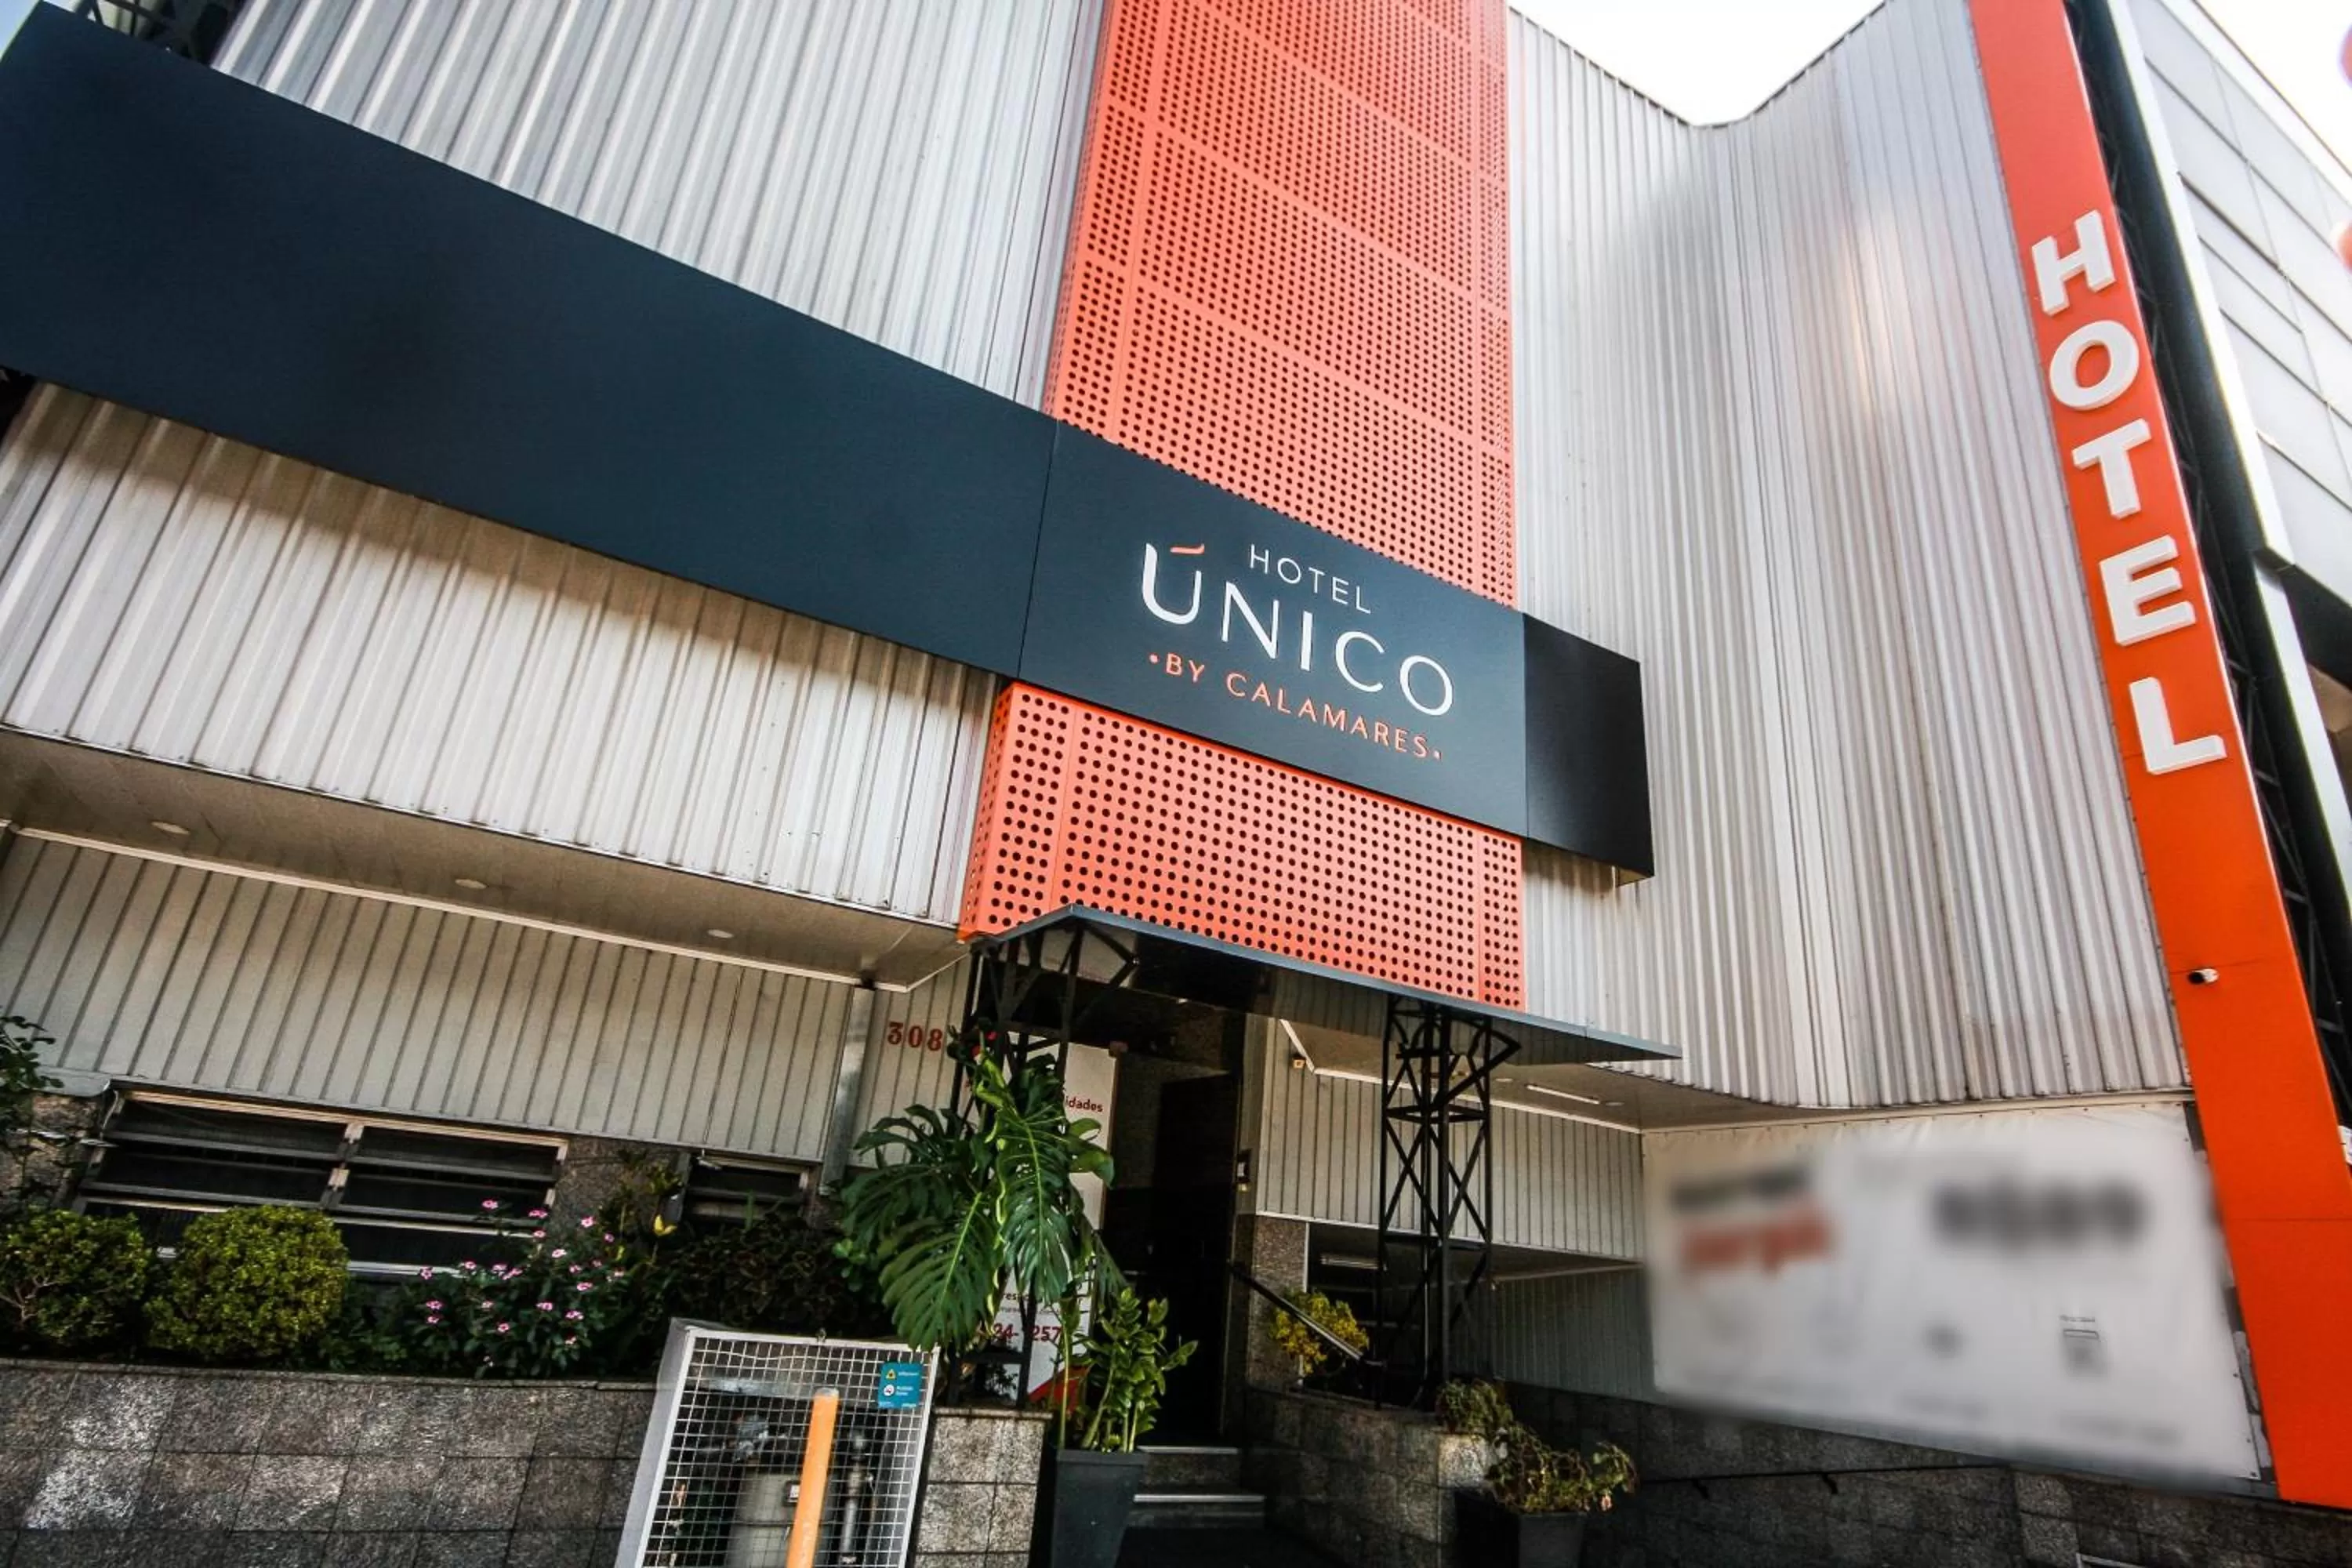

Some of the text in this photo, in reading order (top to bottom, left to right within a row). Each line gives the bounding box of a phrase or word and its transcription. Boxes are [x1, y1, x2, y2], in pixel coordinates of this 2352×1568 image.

[2031, 209, 2227, 776] HOTEL
[1250, 543, 1371, 614] HOTEL
[1165, 652, 1428, 758] BY CALAMARES
[887, 1022, 943, 1051] 308
